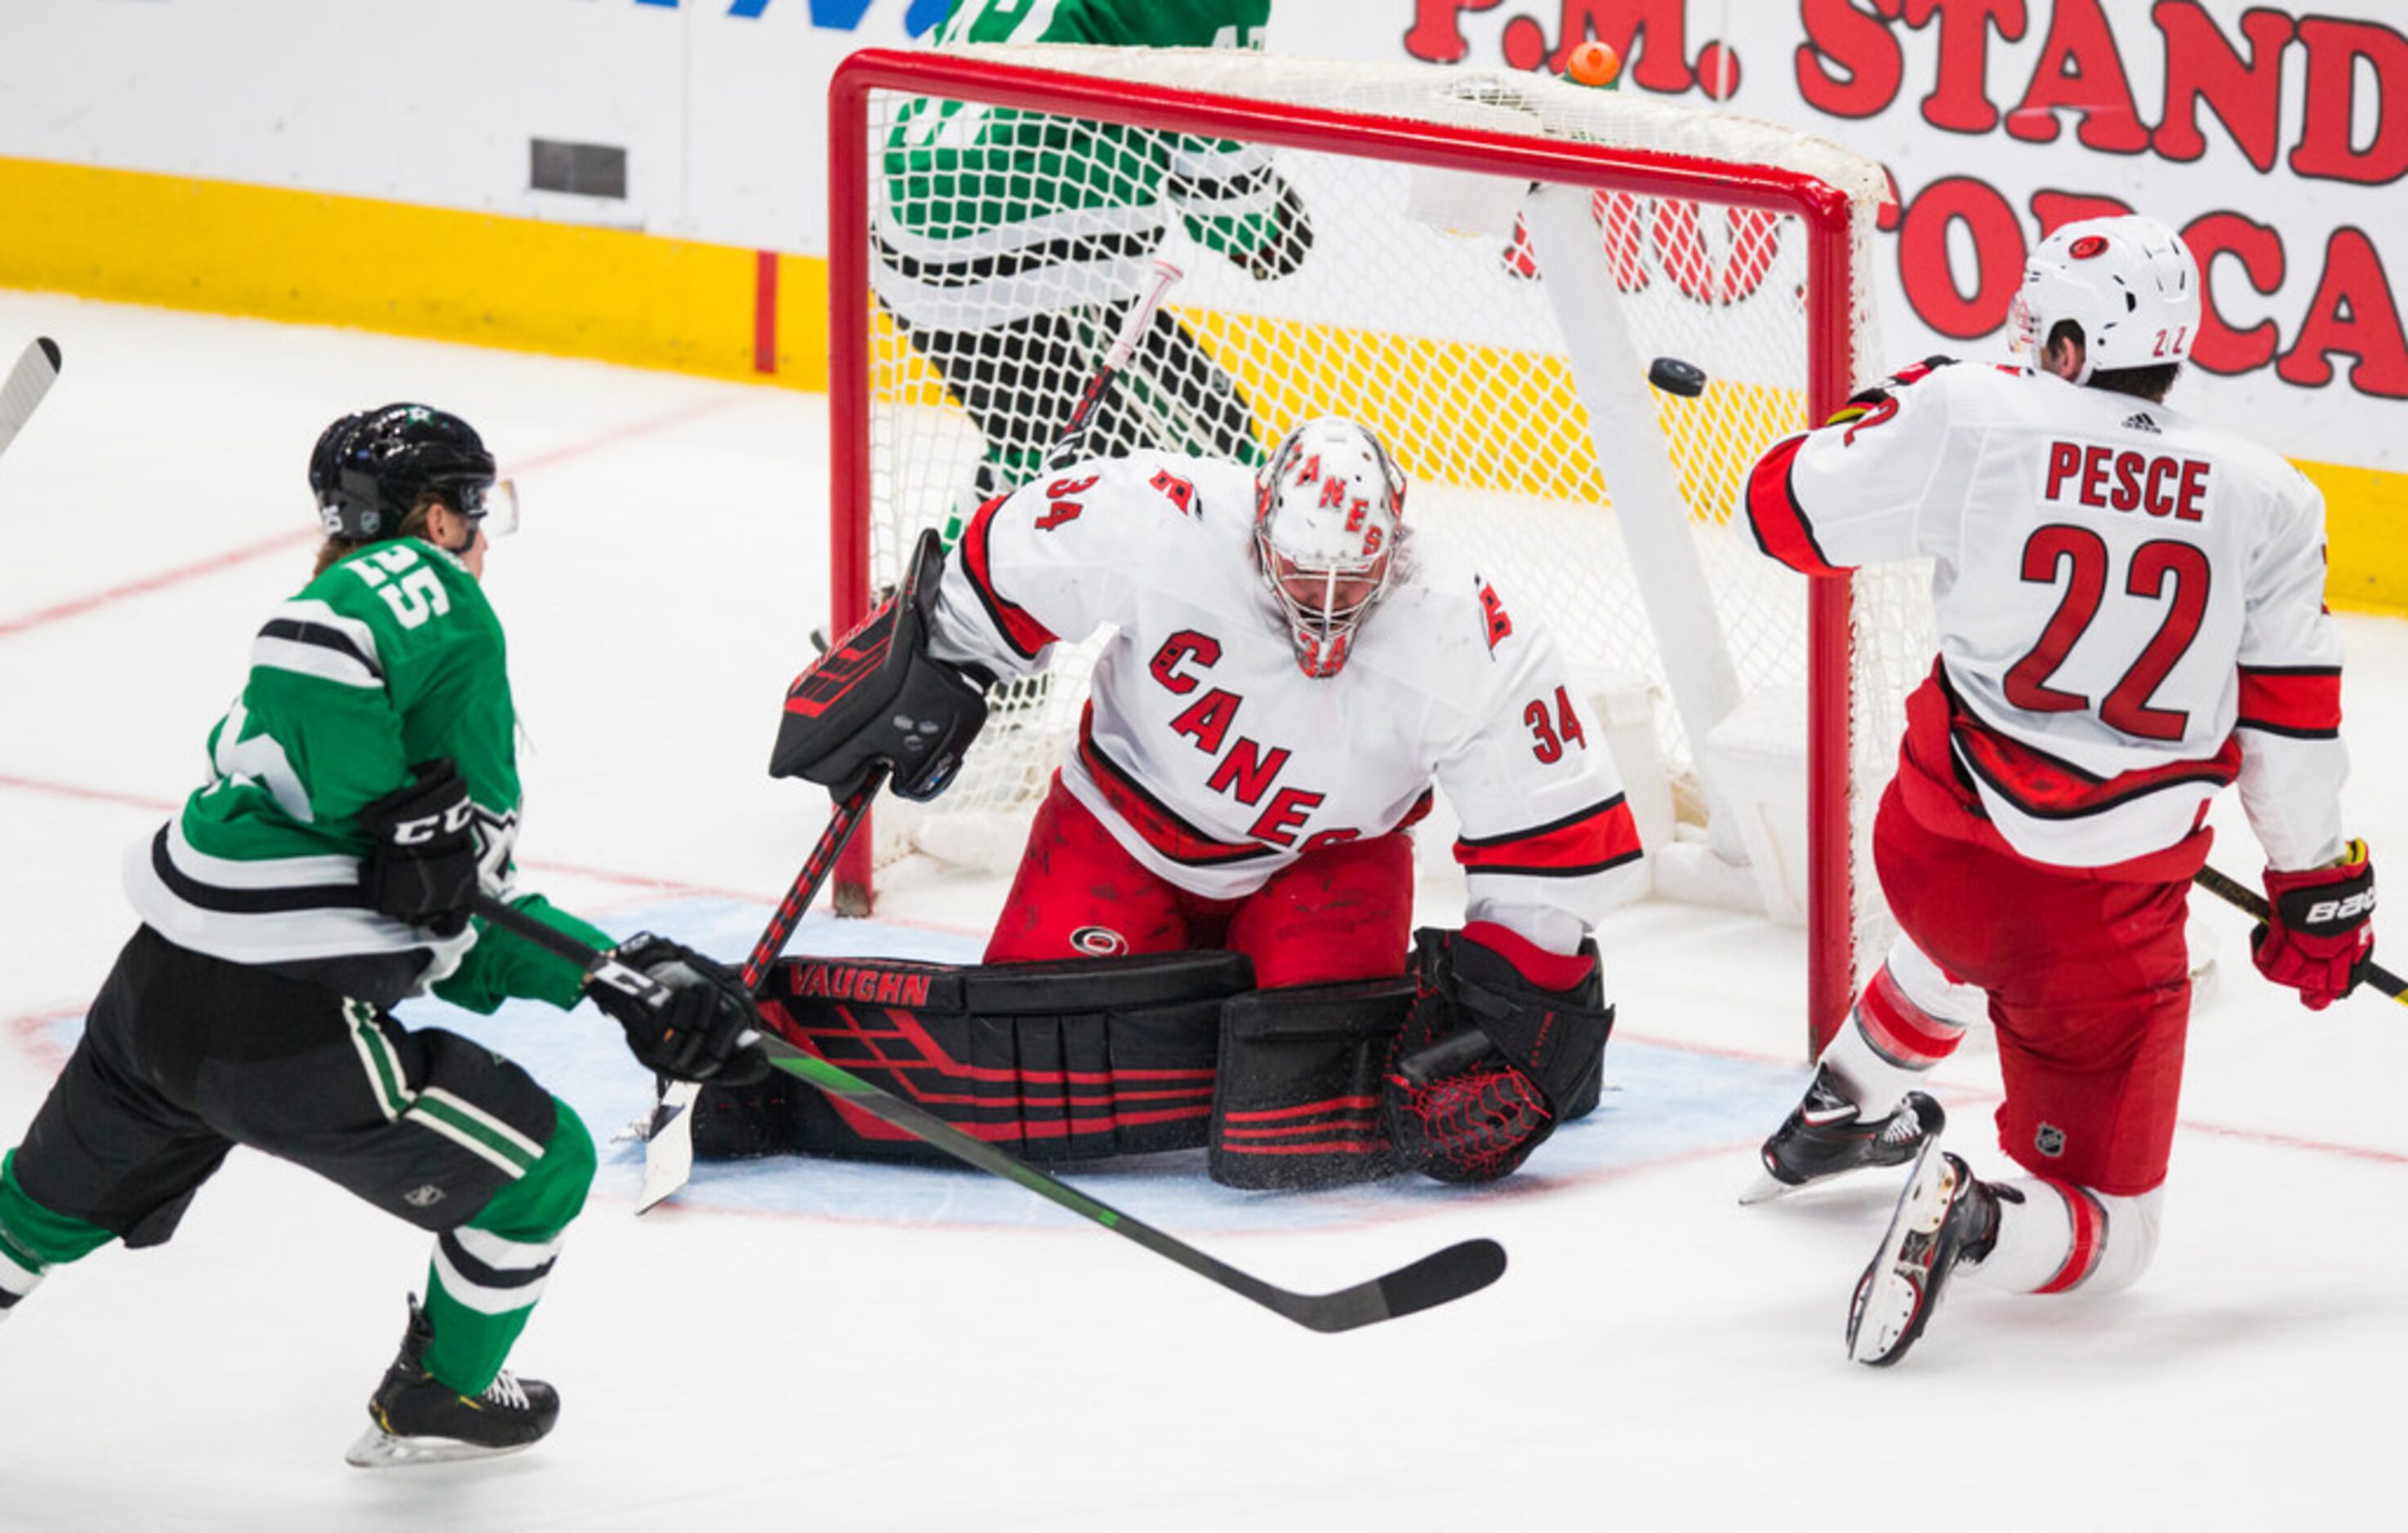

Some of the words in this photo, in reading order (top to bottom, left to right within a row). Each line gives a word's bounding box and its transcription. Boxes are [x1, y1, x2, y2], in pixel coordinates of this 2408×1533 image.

[2152, 326, 2188, 358] 22
[1034, 474, 1100, 531] 34
[2045, 441, 2211, 522] PESCE
[339, 544, 451, 631] 25
[1297, 629, 1351, 678] 34
[2002, 522, 2212, 743] 22
[1523, 683, 1587, 764] 34
[788, 962, 932, 1007] VAUGHN
